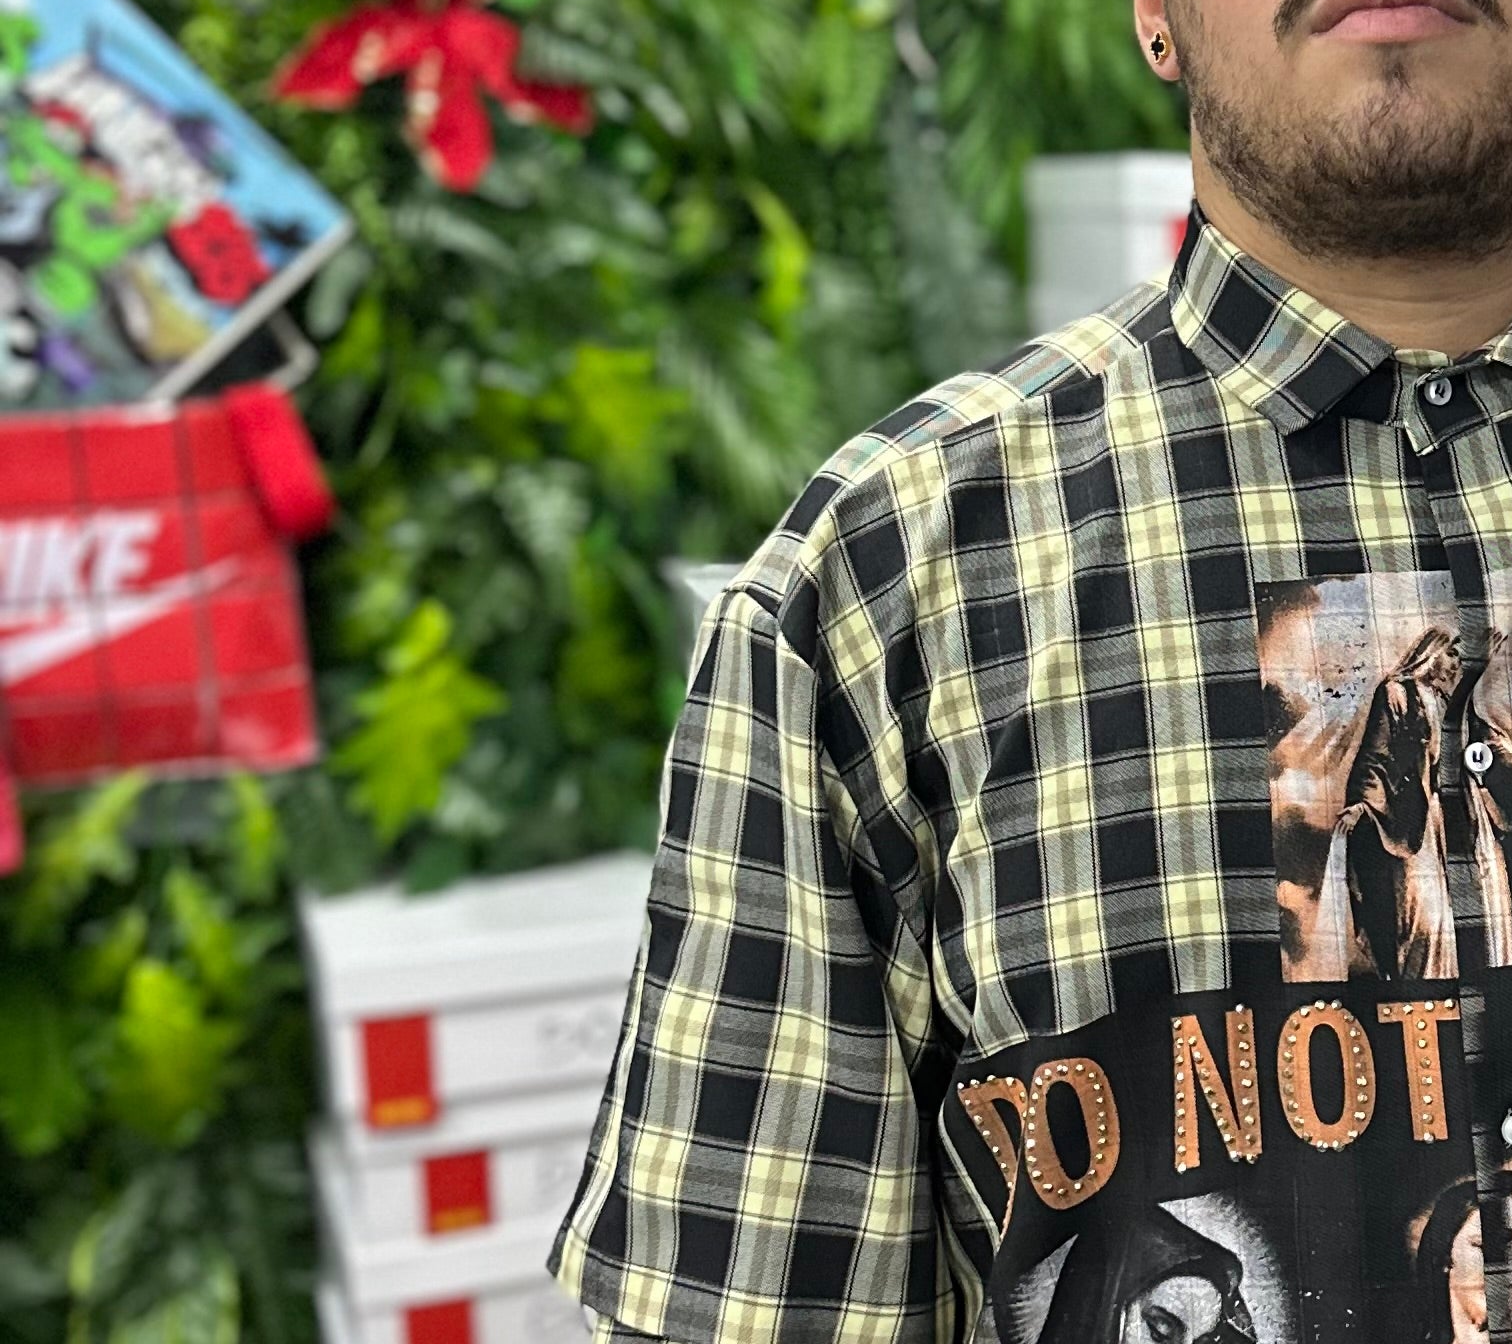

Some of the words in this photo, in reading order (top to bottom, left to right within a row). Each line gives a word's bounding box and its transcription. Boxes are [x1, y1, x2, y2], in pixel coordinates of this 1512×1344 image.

[0, 509, 163, 624] IKE
[957, 1057, 1120, 1238] DO
[1170, 997, 1462, 1175] NOT
